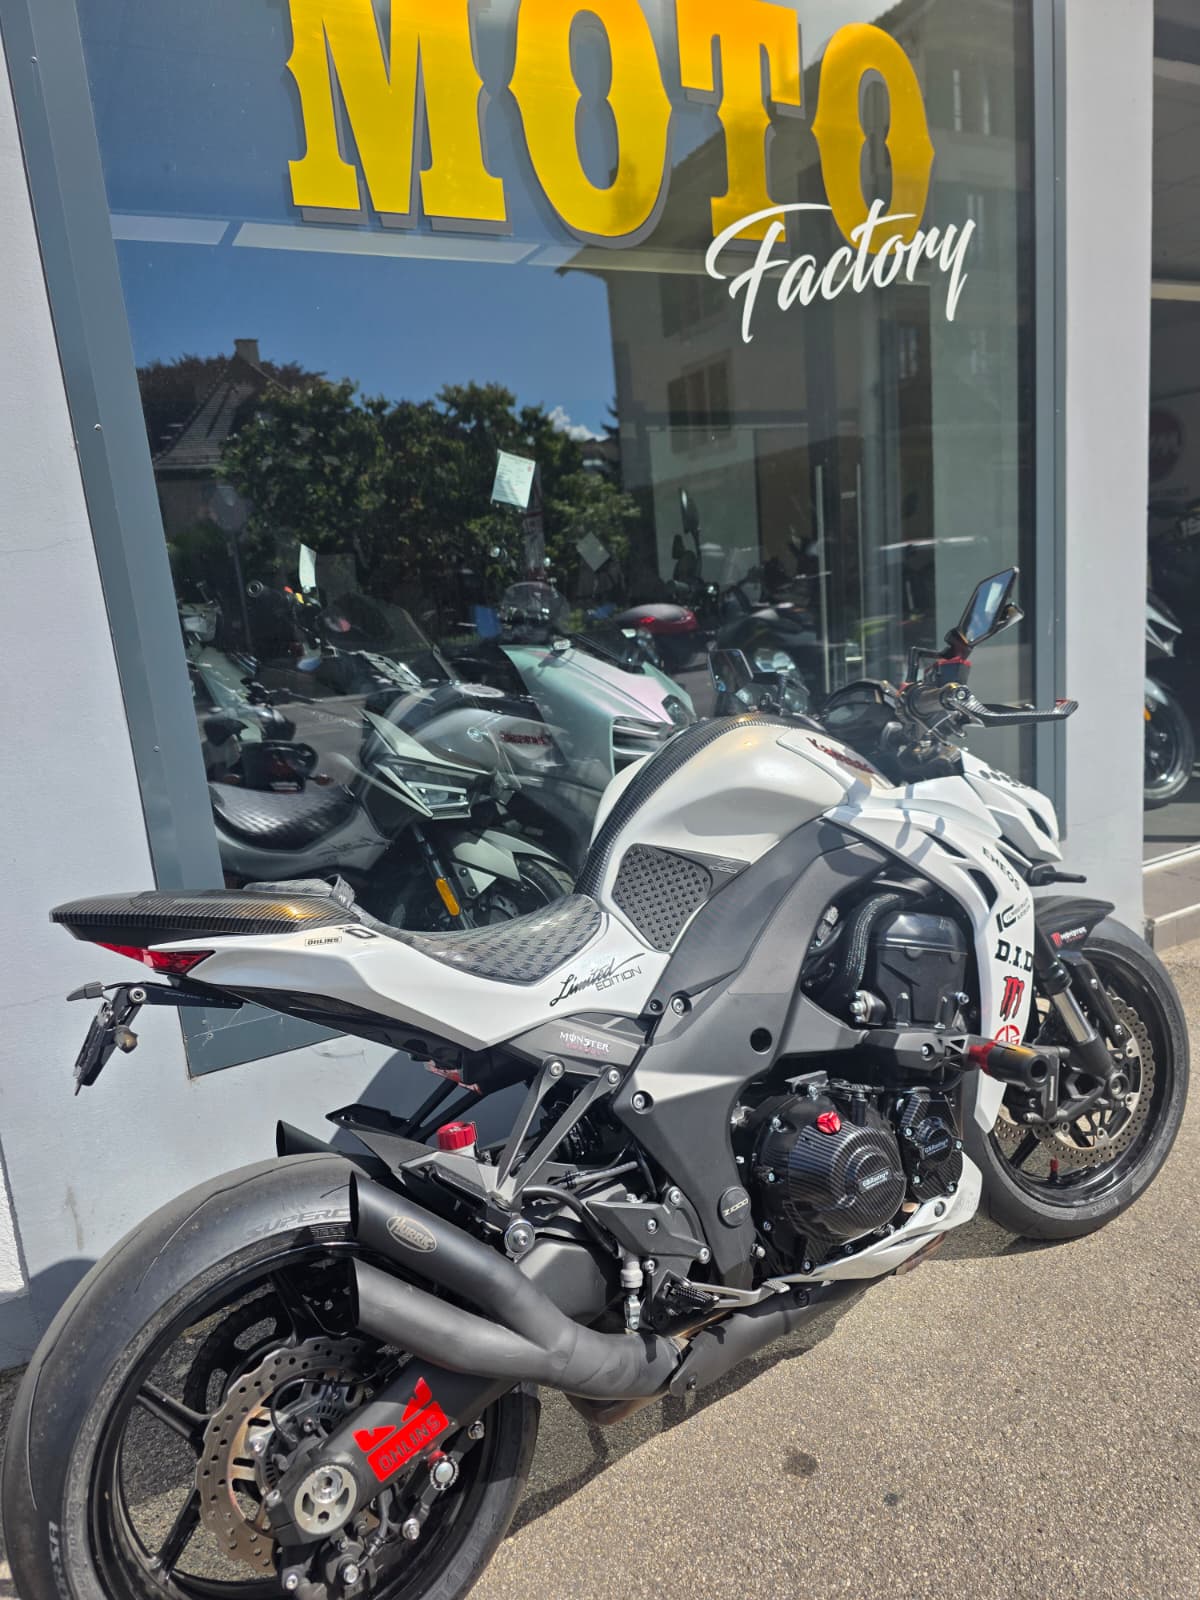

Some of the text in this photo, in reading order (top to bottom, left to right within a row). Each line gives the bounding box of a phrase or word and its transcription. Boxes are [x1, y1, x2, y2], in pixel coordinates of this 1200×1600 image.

[286, 0, 936, 255] MOTO
[704, 198, 978, 343] Factory
[549, 952, 646, 1008] Limited
[595, 966, 642, 992] EDITION
